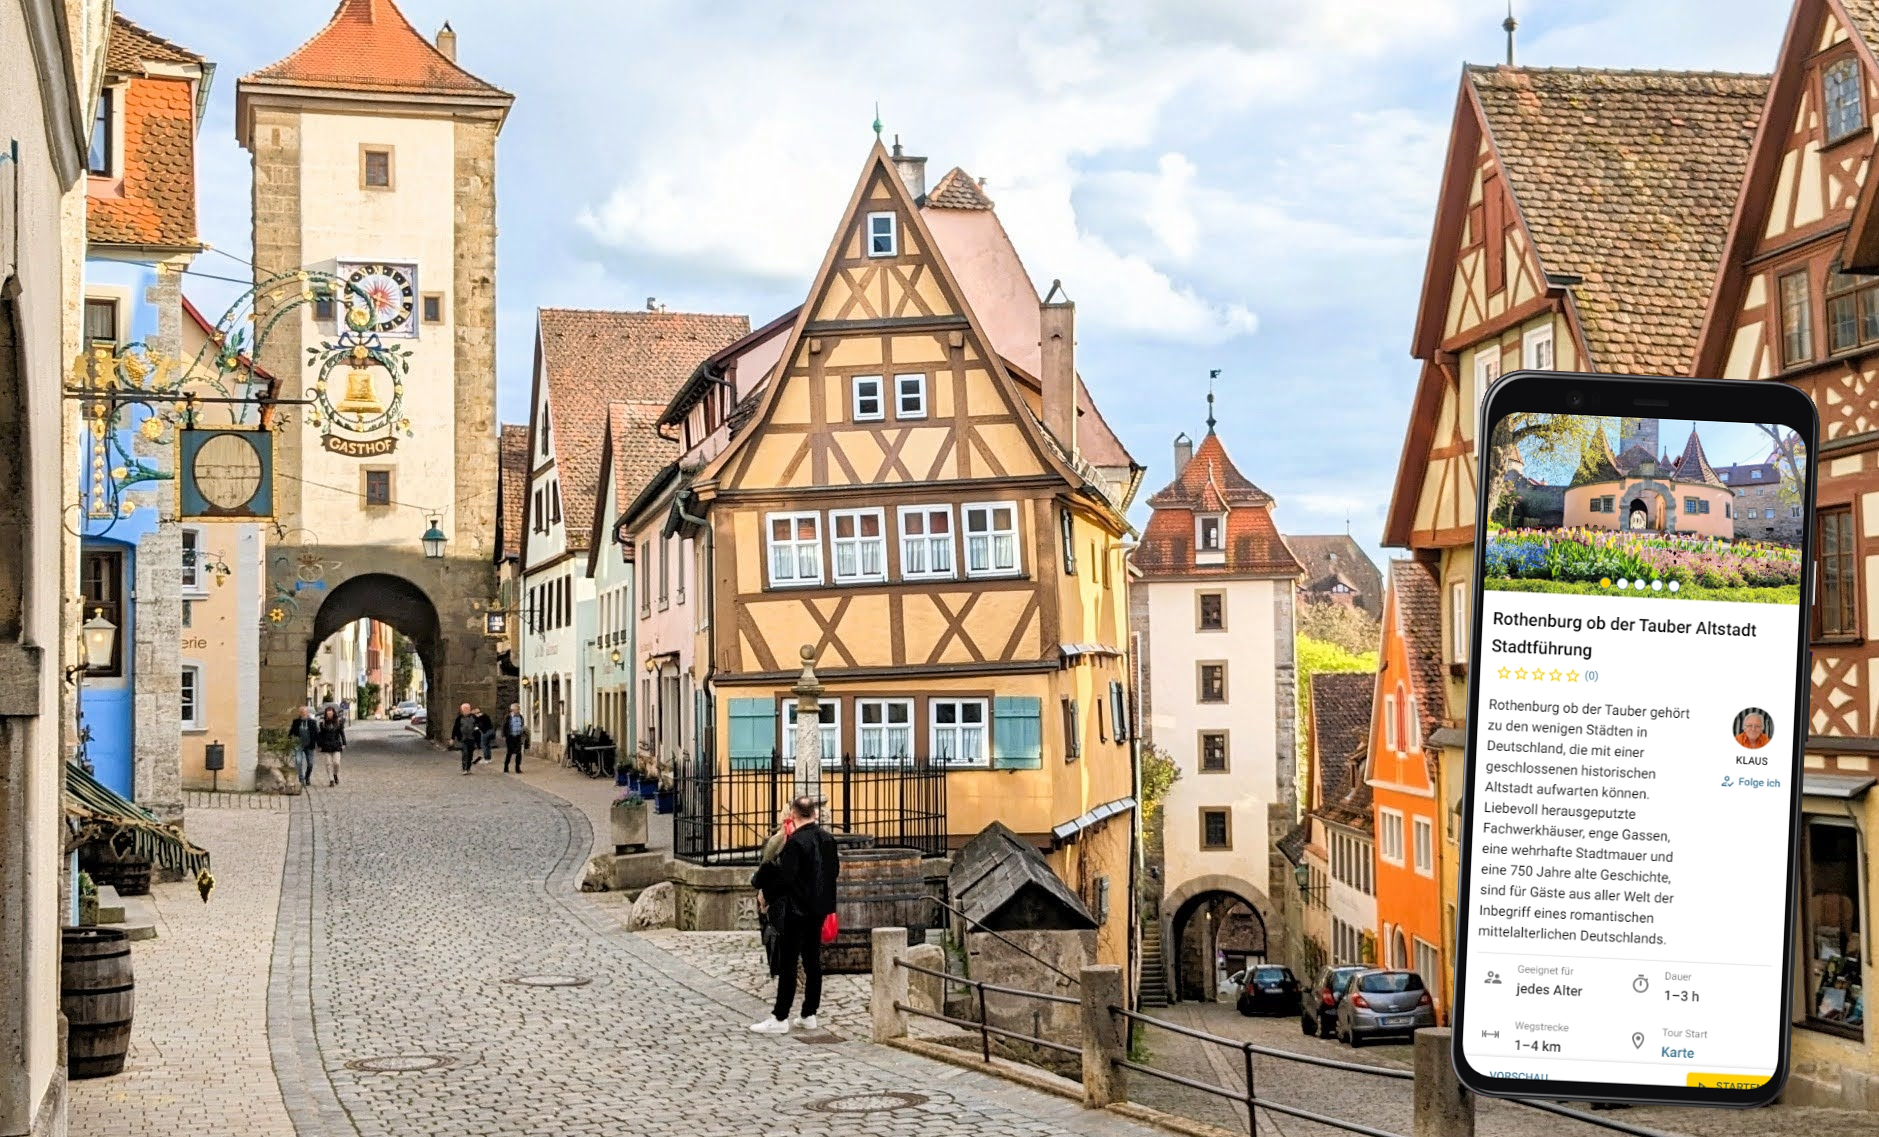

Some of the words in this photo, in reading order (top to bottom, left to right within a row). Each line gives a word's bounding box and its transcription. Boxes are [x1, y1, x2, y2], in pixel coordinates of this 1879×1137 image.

[329, 437, 392, 454] GASTHOF
[1493, 612, 1582, 632] Rothenburg
[1587, 616, 1606, 630] ob
[1610, 617, 1635, 631] der
[1639, 618, 1692, 634] Tauber
[1696, 621, 1756, 637] Altstadt
[1492, 639, 1592, 660] Stadtführung
[1489, 698, 1560, 716] Rothenburg
[1563, 702, 1579, 714] ob
[1582, 703, 1602, 715] der
[1605, 704, 1647, 717] Tauber
[1650, 706, 1690, 720] gehört
[1488, 722, 1502, 731] zu
[1505, 720, 1529, 732] den
[1531, 722, 1583, 737] wenigen
[1586, 724, 1633, 737] Städten
[1637, 726, 1648, 738] in
[1487, 740, 1566, 756] Deutschland,
[1569, 743, 1588, 756] die
[1591, 745, 1611, 757] mit
[1614, 746, 1645, 758] einer
[1486, 761, 1578, 776] geschlossenen
[1581, 764, 1656, 779] historischen
[1736, 756, 1768, 766] KLAUS
[1484, 781, 1533, 794] Altstadt
[1536, 783, 1599, 797] aufwarten
[1601, 786, 1649, 800] können.
[1738, 777, 1765, 789] Folge
[1766, 778, 1781, 788] ich
[1484, 801, 1538, 815] Liebevoll
[1541, 804, 1636, 820] herausgeputzte
[1483, 822, 1585, 839] Fachwerkhäuser,
[1588, 829, 1619, 842] enge
[1622, 828, 1671, 843] Gassen,
[1482, 843, 1508, 855] eine
[1511, 845, 1573, 858] wehrhafte
[1575, 847, 1648, 861] Stadtmauer
[1650, 851, 1673, 863] und
[1481, 863, 1507, 876] eine
[1510, 864, 1533, 877] 750
[1536, 866, 1572, 879] Jahre
[1574, 867, 1597, 880] alte
[1600, 868, 1671, 885] Geschichte,
[1480, 884, 1506, 896] sind
[1510, 884, 1527, 897] für
[1530, 886, 1566, 899] Gäste
[1568, 890, 1591, 900] aus
[1594, 889, 1621, 901] aller
[1624, 891, 1651, 903] Welt
[1654, 892, 1674, 904] der
[1479, 904, 1531, 920] Inbegriff
[1534, 907, 1567, 920] eines
[1570, 911, 1654, 924] romantischen
[1478, 925, 1577, 941] mittelalterlichen
[1580, 930, 1666, 945] Deutschlands.
[1517, 964, 1558, 976] Geeignet
[1561, 966, 1574, 976] für
[1665, 971, 1692, 982] Dauer
[1515, 983, 1550, 997] jedes
[1553, 984, 1583, 997] Alter
[1692, 991, 1700, 1002] h
[1515, 1021, 1569, 1033] Wegstrecke
[1662, 1028, 1683, 1038] Tour
[1685, 1029, 1708, 1039] Start
[1542, 1040, 1561, 1053] km
[1661, 1046, 1695, 1059] Karte
